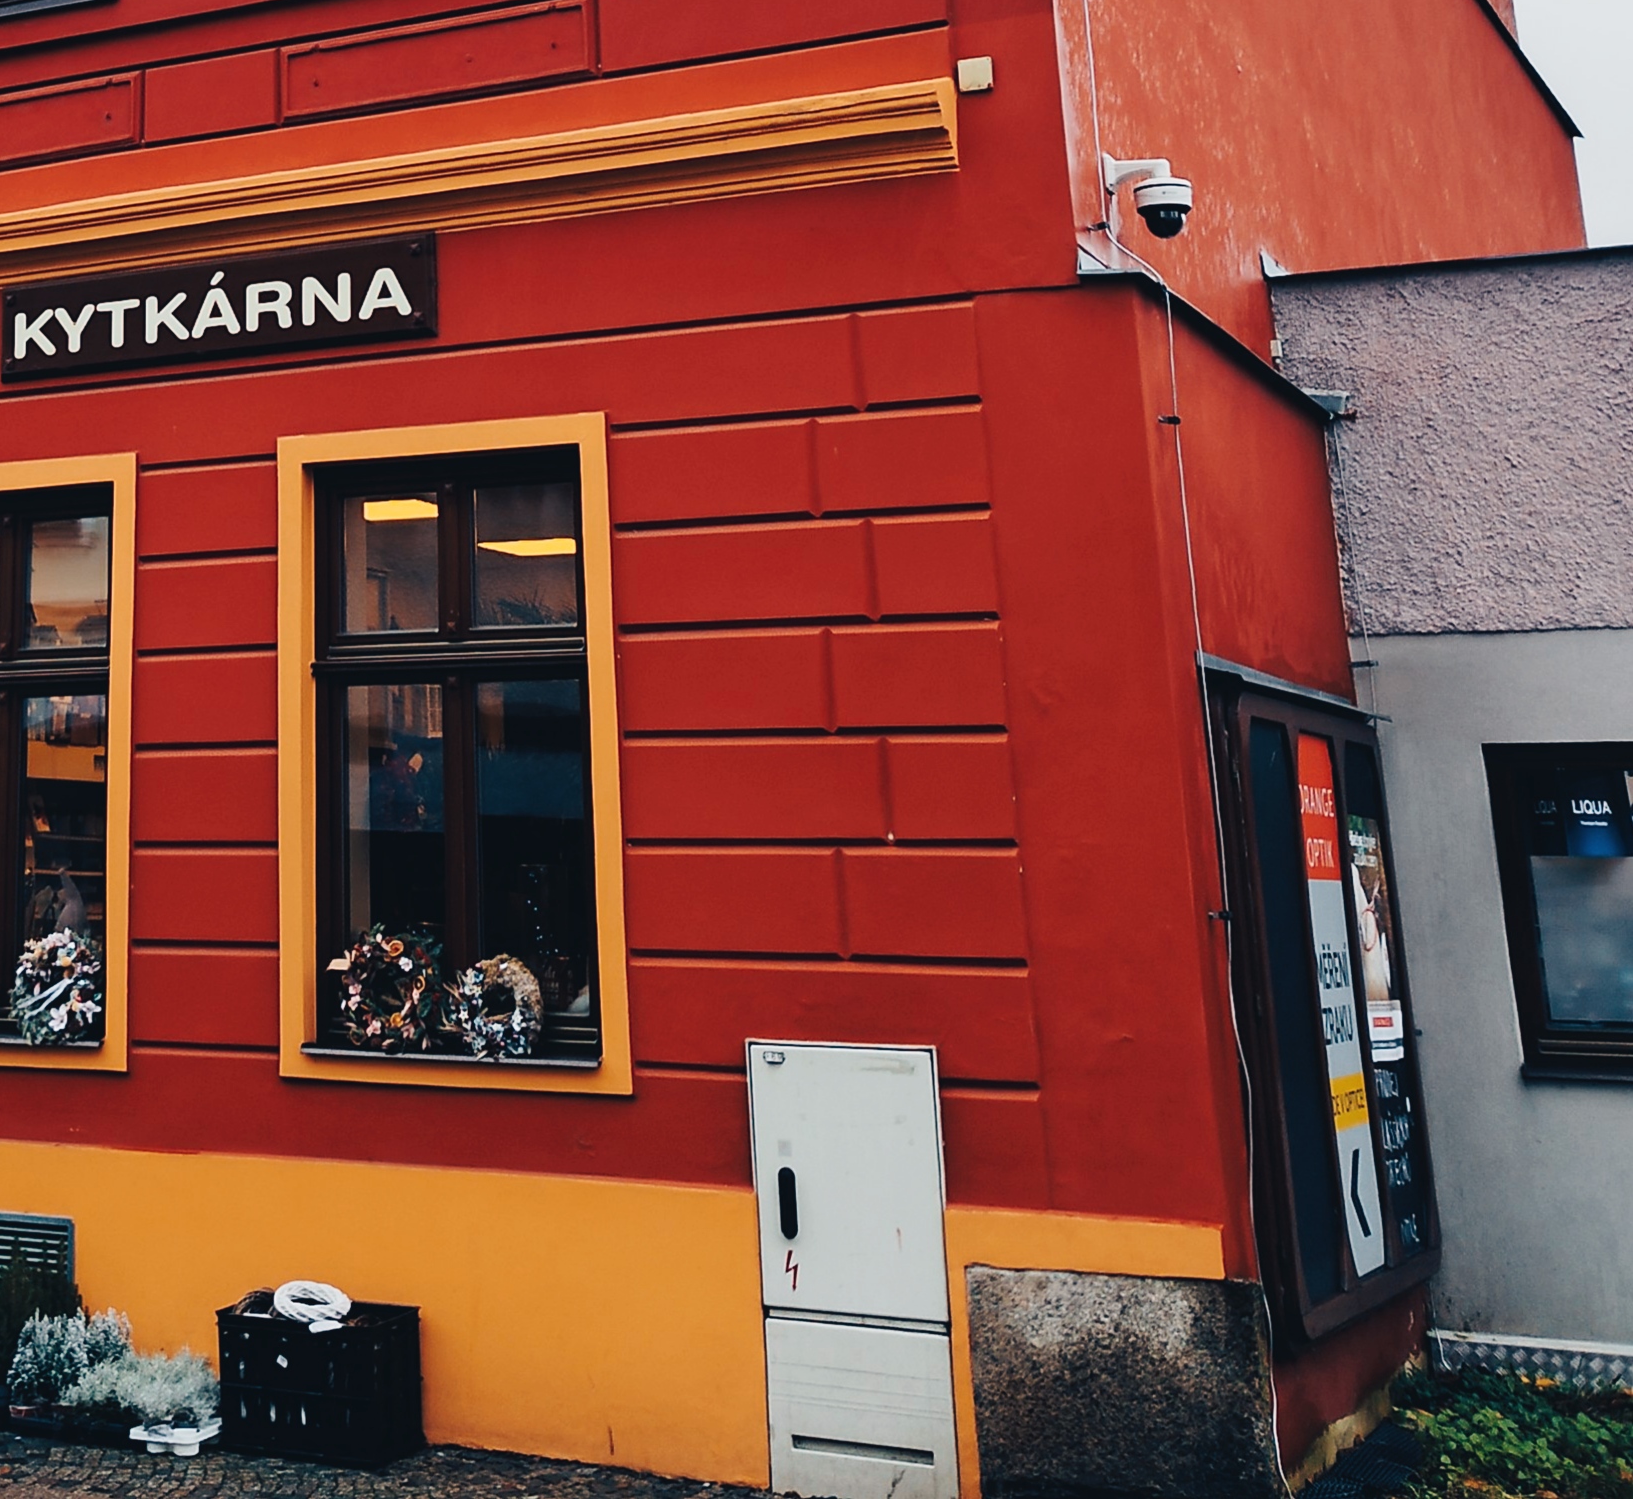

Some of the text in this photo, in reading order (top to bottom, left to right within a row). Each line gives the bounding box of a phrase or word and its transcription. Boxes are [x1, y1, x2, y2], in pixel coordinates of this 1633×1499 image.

[14, 267, 413, 360] KYTKÁRNA
[1571, 799, 1613, 815] LIQUA
[1306, 837, 1334, 868] OPTIK
